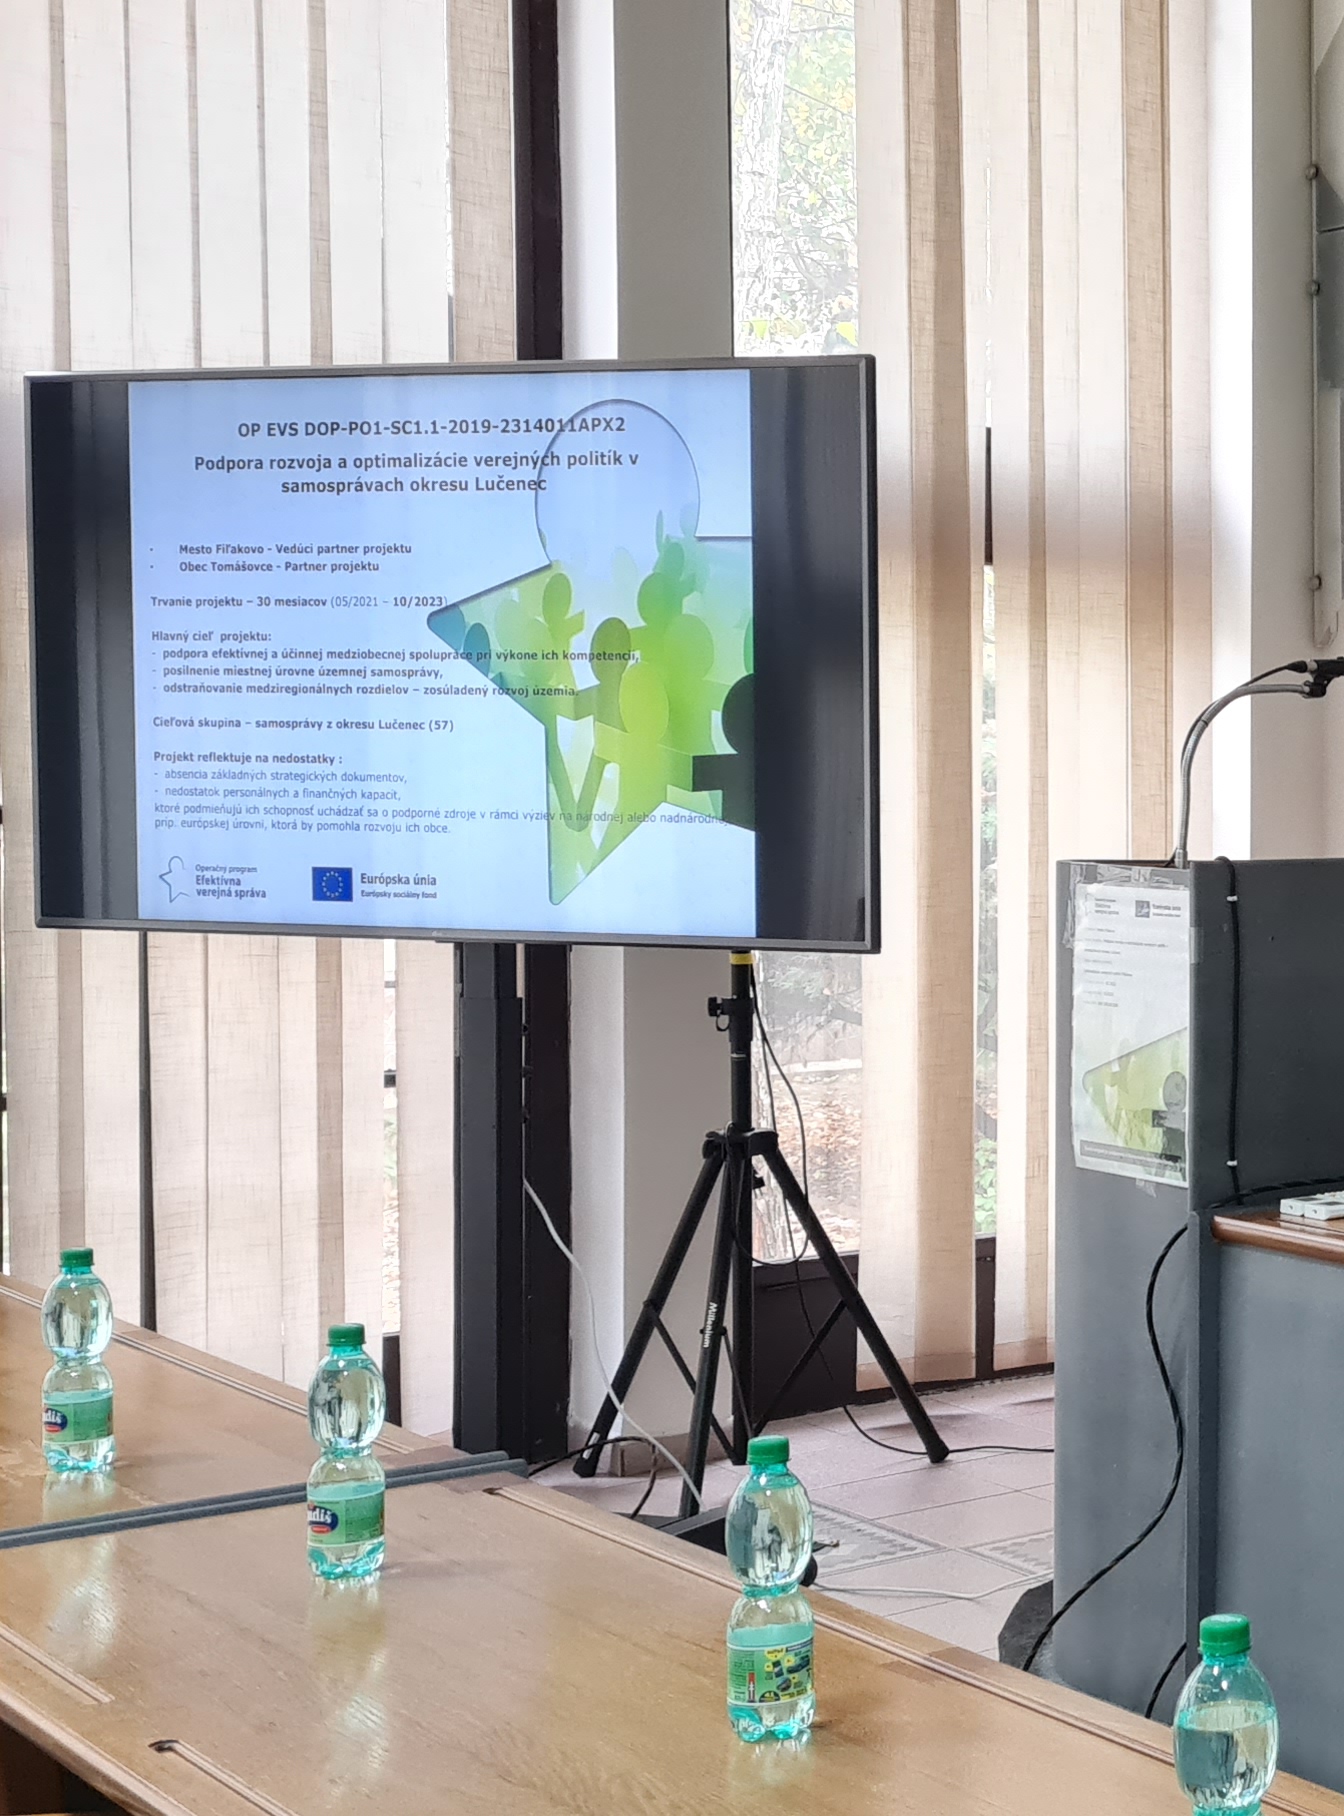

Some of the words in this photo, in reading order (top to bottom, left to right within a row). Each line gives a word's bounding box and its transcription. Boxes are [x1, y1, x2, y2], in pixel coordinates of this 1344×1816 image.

[238, 423, 261, 437] OP
[267, 422, 298, 437] EVS
[195, 456, 263, 473] Podpora
[270, 454, 331, 472] rozvoja
[338, 458, 347, 468] a
[353, 451, 467, 472] optimalizácie
[474, 451, 560, 470] verejných
[567, 450, 623, 469] politík
[629, 454, 638, 464] v
[282, 476, 403, 495] samosprávach
[410, 477, 468, 491] okresu
[475, 475, 547, 491] Lučenec
[179, 544, 212, 554] Mesto
[216, 544, 264, 554] Fiľakovo
[275, 544, 313, 554] Vedúci
[317, 545, 359, 556] partner
[363, 544, 411, 556] projektu
[179, 561, 207, 572] Obec
[211, 560, 273, 572] Tomášovce
[285, 562, 327, 572] Partner
[331, 561, 380, 573] projektu
[151, 596, 193, 607] Trvanie
[196, 596, 243, 609] projektu
[257, 597, 271, 606] 30
[274, 597, 327, 607] mesiacov
[330, 596, 378, 608] (05/2021
[392, 596, 448, 608] 10/2023)
[152, 630, 189, 643] Hlavný
[192, 631, 213, 641] cieľ
[220, 631, 272, 644] projektu:
[163, 649, 208, 661] podpora
[212, 648, 268, 661] efektívnej
[271, 651, 278, 659] a
[281, 648, 323, 662] účinnej
[326, 649, 406, 662] medziobecnej
[409, 649, 474, 662] spolupráce
[476, 650, 491, 663] pri
[496, 649, 538, 663] výkone
[542, 650, 558, 661] ich
[163, 666, 220, 679] posilnenie
[223, 666, 272, 679] miestnej
[275, 666, 315, 677] úrovne
[318, 666, 367, 679] územnej
[370, 667, 443, 680] samosprávy,
[163, 682, 243, 694] odstraňovanie
[246, 683, 352, 696] medziregionálnych
[356, 684, 409, 695] rozdielov
[423, 684, 488, 698] zosúladený
[492, 685, 529, 698] rozvoj
[533, 685, 579, 697] územia.
[153, 717, 195, 728] Cieľová
[198, 717, 241, 730] skupina
[255, 717, 323, 731] samosprávy
[336, 718, 375, 729] okresu
[379, 718, 425, 730] Lučenec
[429, 719, 454, 732] (57)
[154, 751, 194, 764] Projekt
[197, 752, 252, 764] reflektuje
[255, 754, 269, 763] na
[272, 753, 335, 766] nedostatky
[164, 769, 208, 780] absencia
[211, 769, 267, 782] základných
[270, 770, 338, 783] strategických
[341, 771, 407, 784] dokumentov,
[165, 785, 220, 797] nedostatok
[223, 787, 289, 800] personálnych
[293, 789, 299, 798] a
[303, 787, 357, 800] finančných
[361, 789, 401, 801] kapacit,
[154, 803, 180, 814] ktoré
[246, 805, 260, 815] ich
[263, 804, 314, 817] schopnosť
[317, 806, 364, 817] uchádzať
[367, 809, 379, 817] sa
[382, 809, 388, 817] o
[392, 807, 441, 819] podporné
[444, 807, 476, 821] zdroje
[480, 810, 486, 818] v
[490, 807, 518, 819] rámci
[522, 808, 555, 822] výziev
[559, 811, 572, 821] na
[576, 810, 623, 824] národnej
[628, 811, 656, 823] alebo
[180, 819, 229, 831] európskej
[233, 818, 267, 830] úrovni,
[271, 819, 298, 830] ktorá
[301, 820, 313, 832] by
[316, 821, 360, 832] pomohla
[364, 823, 402, 833] rozvoju
[406, 823, 420, 833] ich
[424, 823, 451, 833] obce.
[196, 875, 241, 886] Efektívna
[361, 873, 410, 887] Európska
[414, 873, 436, 885] únia
[196, 887, 232, 898] verejná
[235, 888, 266, 898] správa
